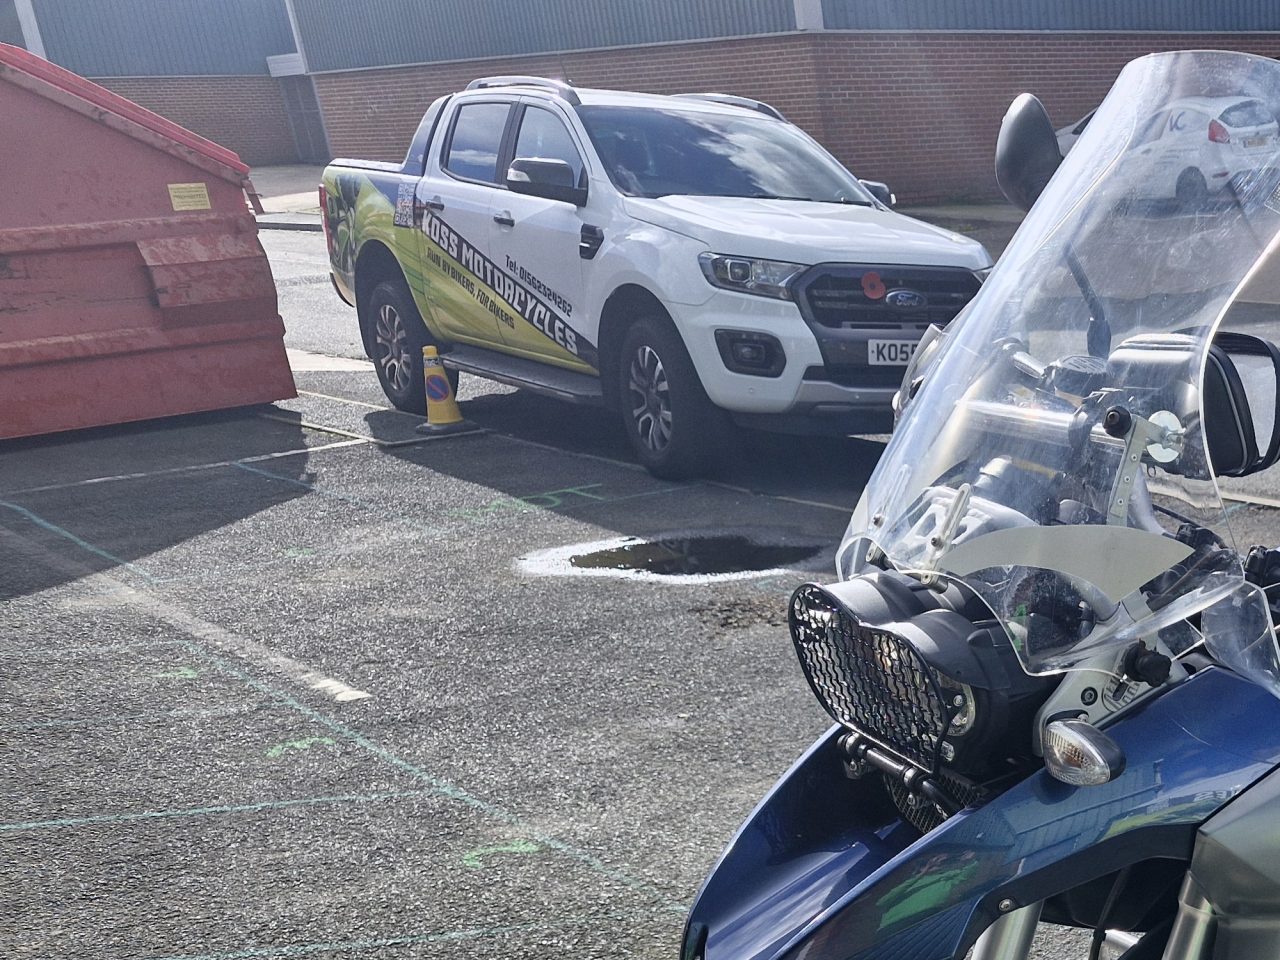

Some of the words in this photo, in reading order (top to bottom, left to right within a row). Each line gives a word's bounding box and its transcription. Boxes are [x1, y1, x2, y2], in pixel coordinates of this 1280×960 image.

[422, 210, 458, 258] KOSS
[461, 243, 578, 354] MOTORCYCLES
[427, 248, 441, 267] RUN
[442, 257, 451, 275] BY
[451, 264, 475, 298] BIKERS,
[476, 288, 489, 309] FOR
[489, 299, 515, 329] BIKERS
[505, 254, 519, 274] Tel:
